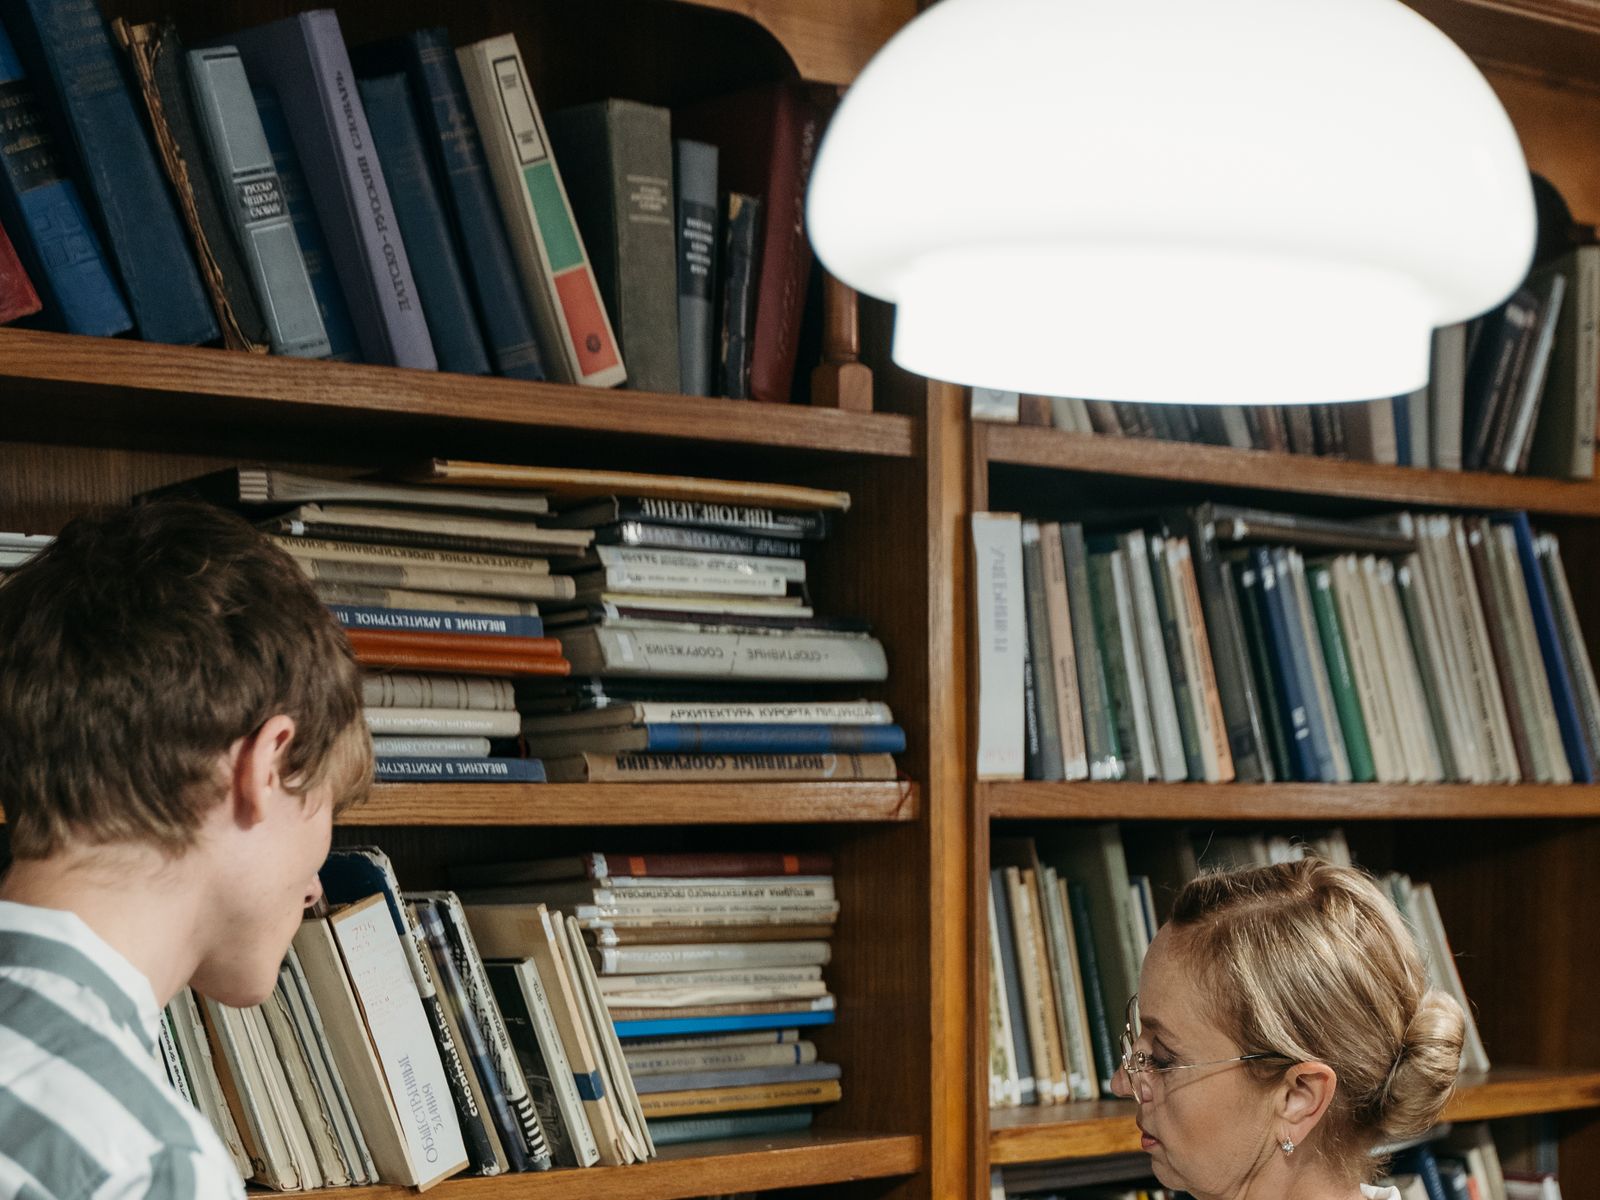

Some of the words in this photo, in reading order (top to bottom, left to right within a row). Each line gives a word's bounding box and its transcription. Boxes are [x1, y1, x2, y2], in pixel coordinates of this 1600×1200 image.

[333, 69, 364, 150] СЛОВАРЬ
[332, 541, 435, 561] ПРОЕКТИРОВАНИЕ
[438, 551, 533, 571] АРХИТЕКТУРНОЕ
[354, 612, 440, 628] АРХИТЕКТУРНОЕ
[443, 617, 452, 629] В
[454, 617, 506, 632] ВВЕДЕНИЕ
[644, 643, 723, 658] СООРУЖЕНИЯ
[745, 647, 822, 663] СПОРТИВНЫЕ
[670, 707, 754, 719] АРХИТЕКТУРА
[759, 706, 810, 717] КУРОРТА
[445, 762, 453, 774] В
[456, 762, 508, 774] ВВЕДЕНИЕ
[615, 754, 725, 770] СООРУЖЕНИЯ
[430, 999, 479, 1118] спортивные
[395, 1052, 440, 1165] ОБЩЕСТВЕННЫЕ
[418, 1081, 447, 1135] ЗДАНИЯ
